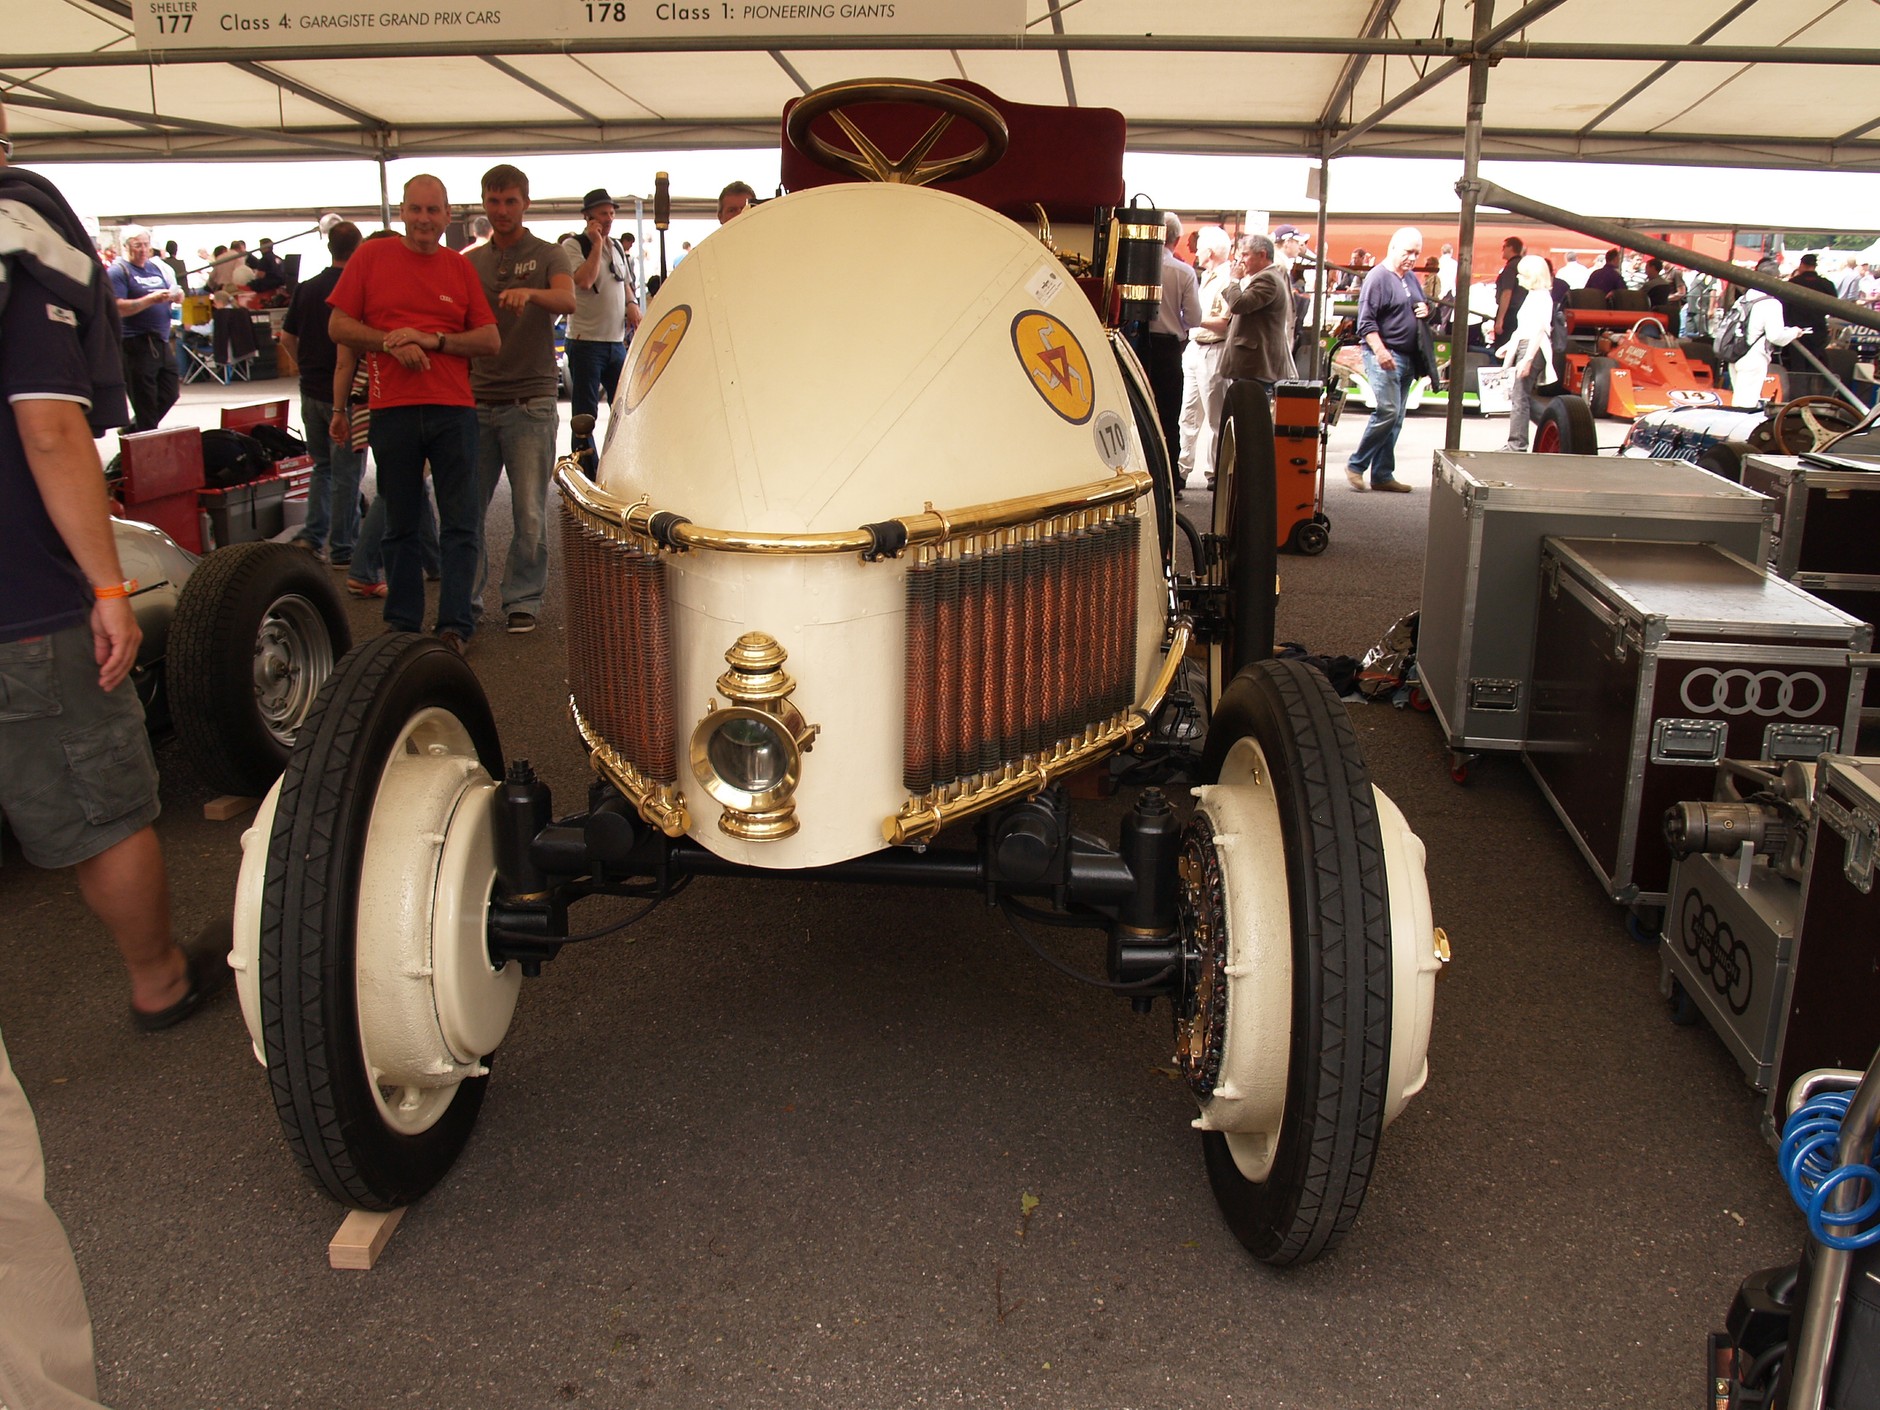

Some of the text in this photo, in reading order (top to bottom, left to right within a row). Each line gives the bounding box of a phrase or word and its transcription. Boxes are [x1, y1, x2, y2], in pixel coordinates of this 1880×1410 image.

[150, 1, 198, 13] SHELTER
[585, 2, 626, 23] 178
[656, 2, 895, 20] Class 1: PIONEERING GIANTS
[156, 14, 193, 34] 177
[220, 10, 501, 31] Class 4: GARAGISTE GRAND PRIX CARS
[1681, 391, 1705, 400] 14
[1098, 423, 1125, 459] 170
[1693, 921, 1738, 980] AUTO UNION
